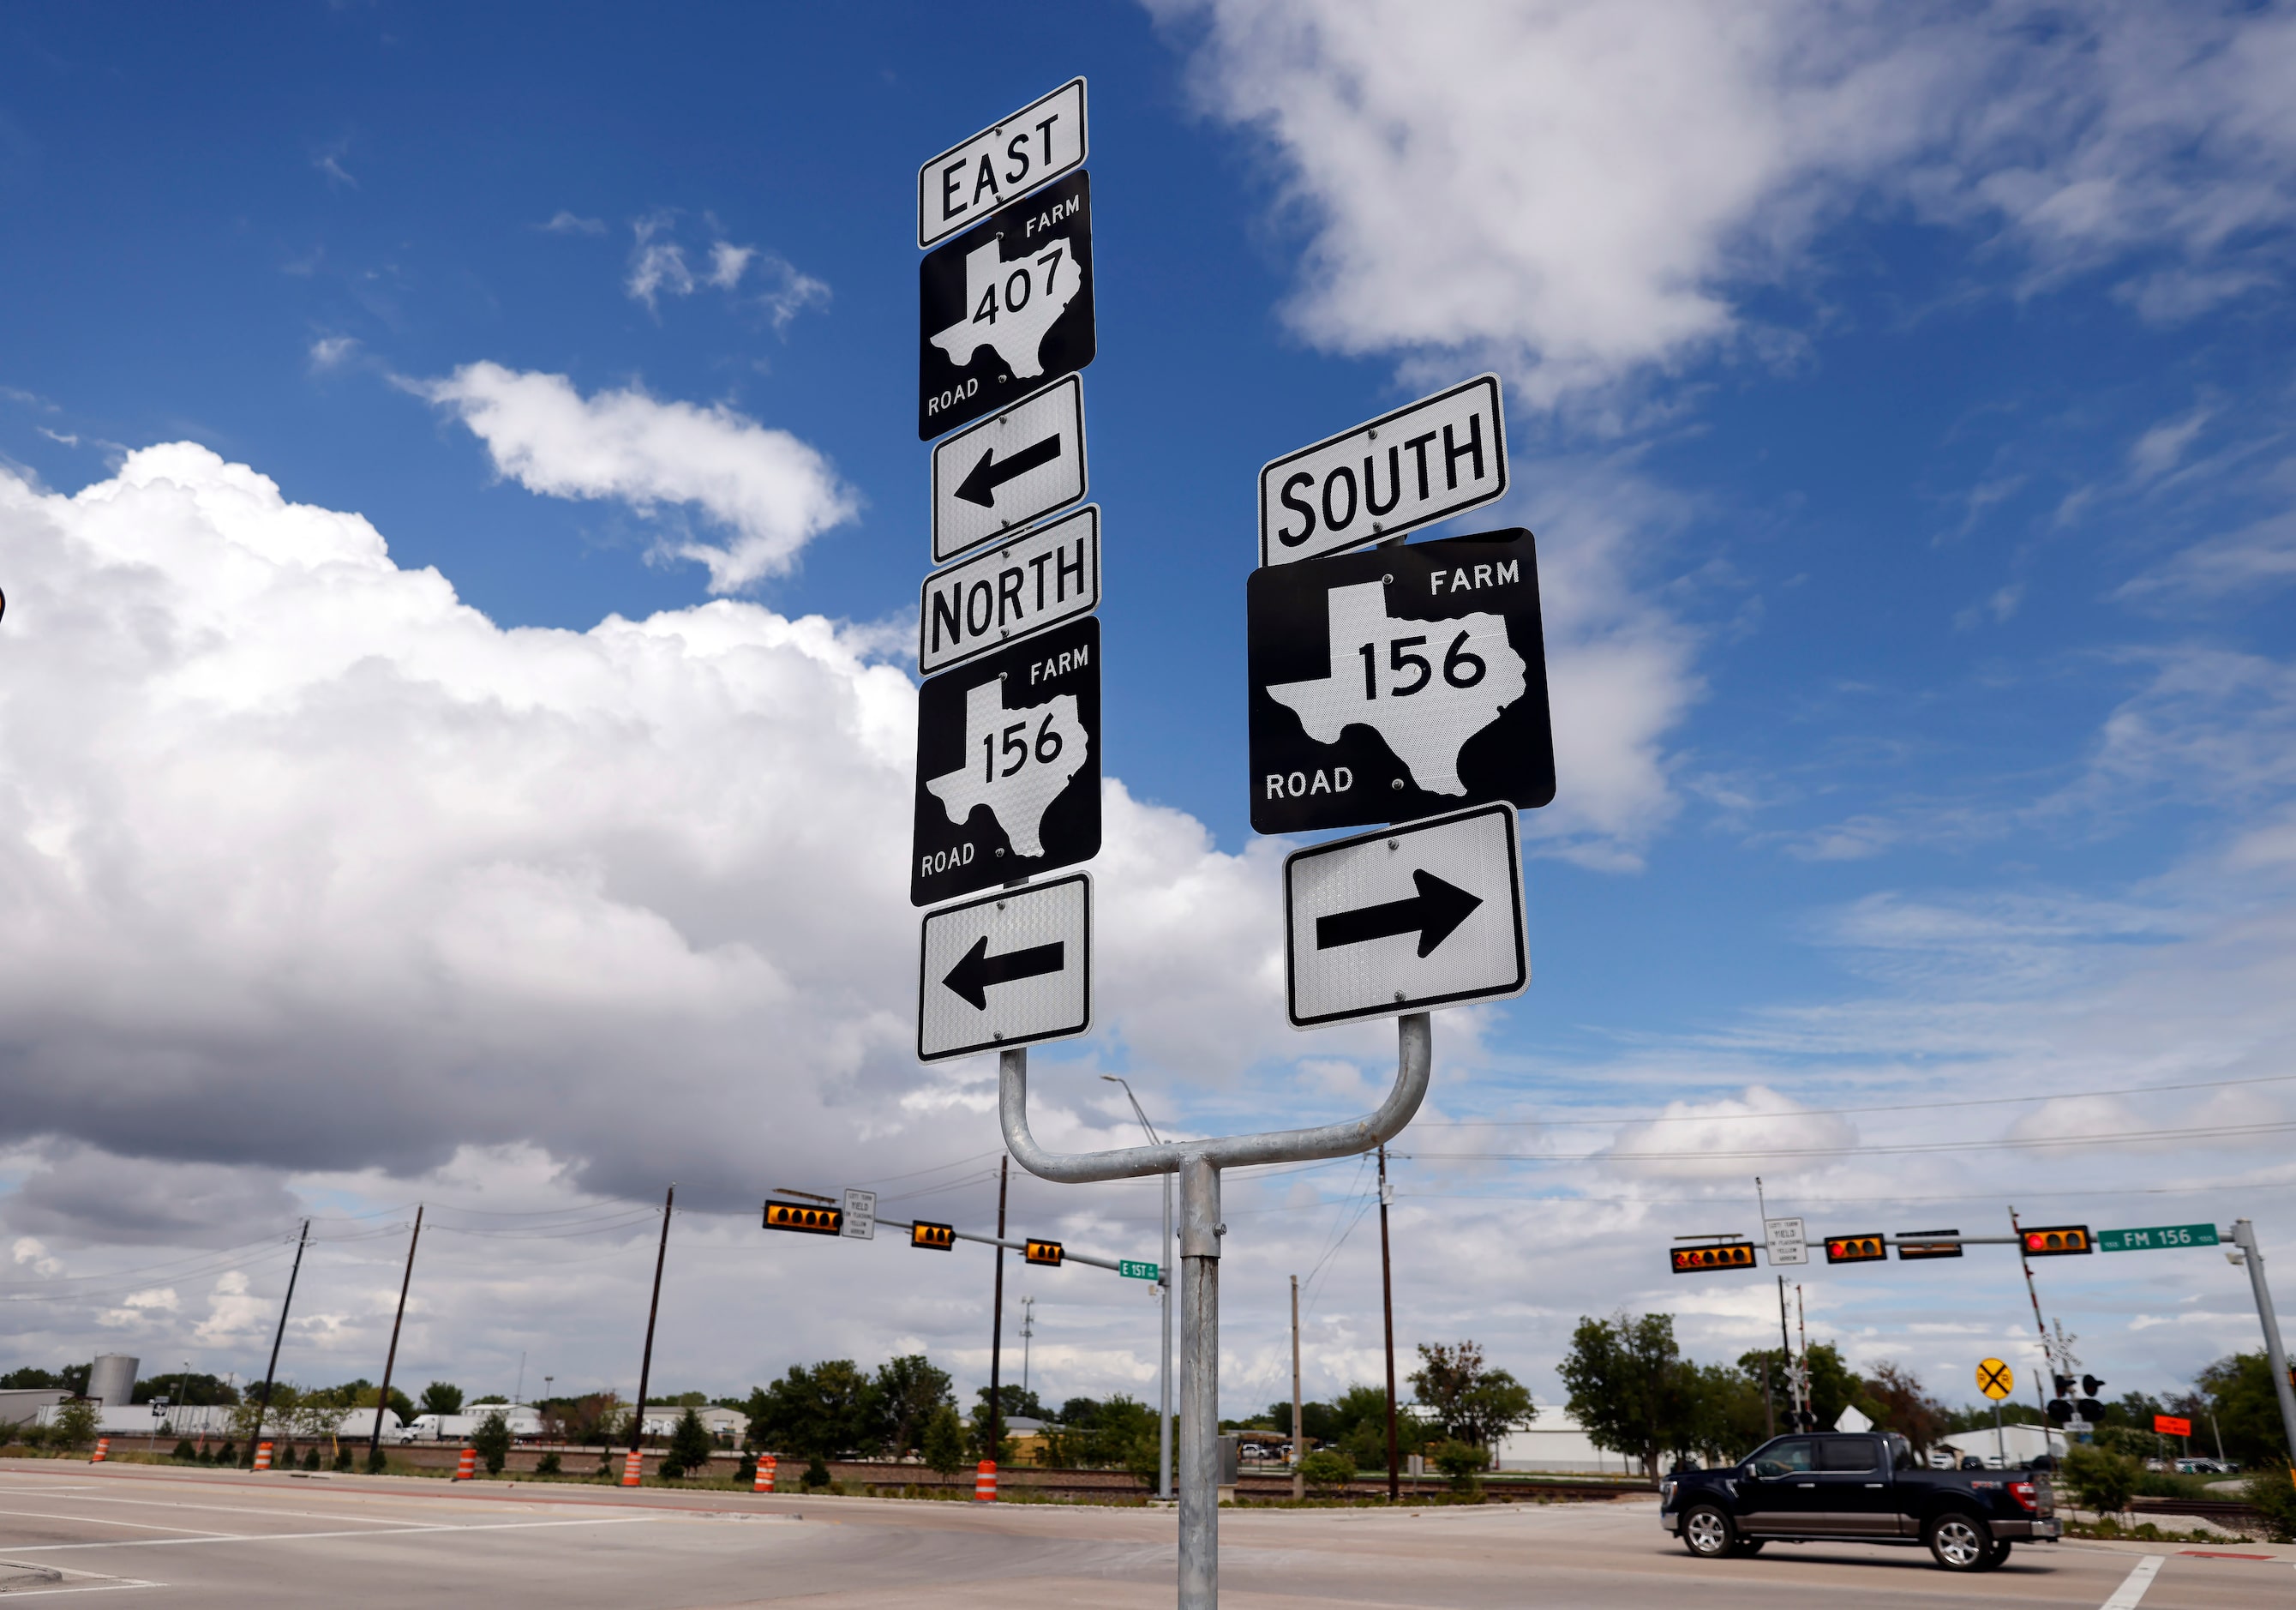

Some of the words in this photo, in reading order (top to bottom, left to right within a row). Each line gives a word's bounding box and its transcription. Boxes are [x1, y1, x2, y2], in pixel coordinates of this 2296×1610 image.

[943, 113, 1058, 221] EAST
[1026, 195, 1080, 238] FARM
[972, 247, 1063, 326] 407
[927, 377, 979, 417] ROAD
[1278, 412, 1485, 548] SOUTH
[932, 537, 1084, 654] NORTH
[1430, 559, 1520, 597] FARM
[1030, 645, 1089, 686] FARM
[1358, 629, 1487, 701] 156
[983, 712, 1064, 784] 156
[1266, 766, 1354, 800] ROAD
[920, 842, 975, 878] ROAD
[851, 1201, 868, 1211] YIELD
[1774, 1229, 1796, 1238] YIELD
[2123, 1231, 2151, 1247] FM
[2157, 1229, 2192, 1246] 156
[1123, 1262, 1129, 1276] E
[1131, 1264, 1147, 1277] 1ST
